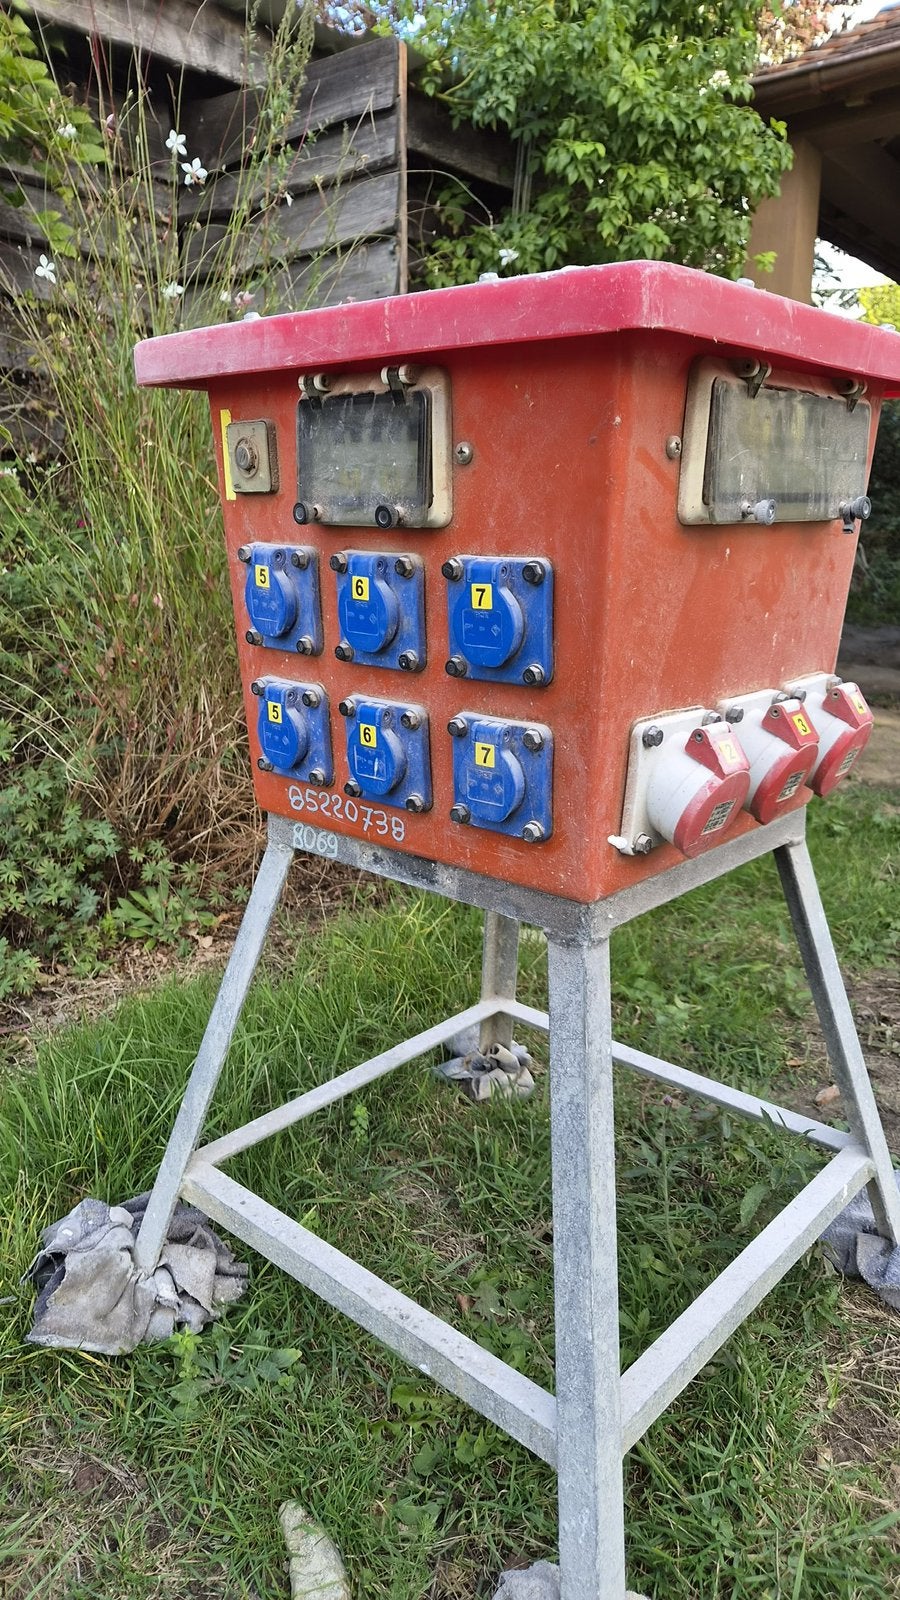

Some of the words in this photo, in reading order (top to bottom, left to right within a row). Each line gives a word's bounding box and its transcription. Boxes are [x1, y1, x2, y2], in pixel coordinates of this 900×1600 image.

[259, 568, 267, 584] 5
[355, 579, 364, 596] 6
[476, 588, 486, 607] 7
[272, 705, 279, 720] 5
[797, 718, 808, 733] 3
[363, 727, 371, 743] 6
[481, 746, 491, 764] 7
[725, 744, 736, 759] 2
[288, 785, 405, 842] 85220738
[293, 823, 338, 858] 8069
